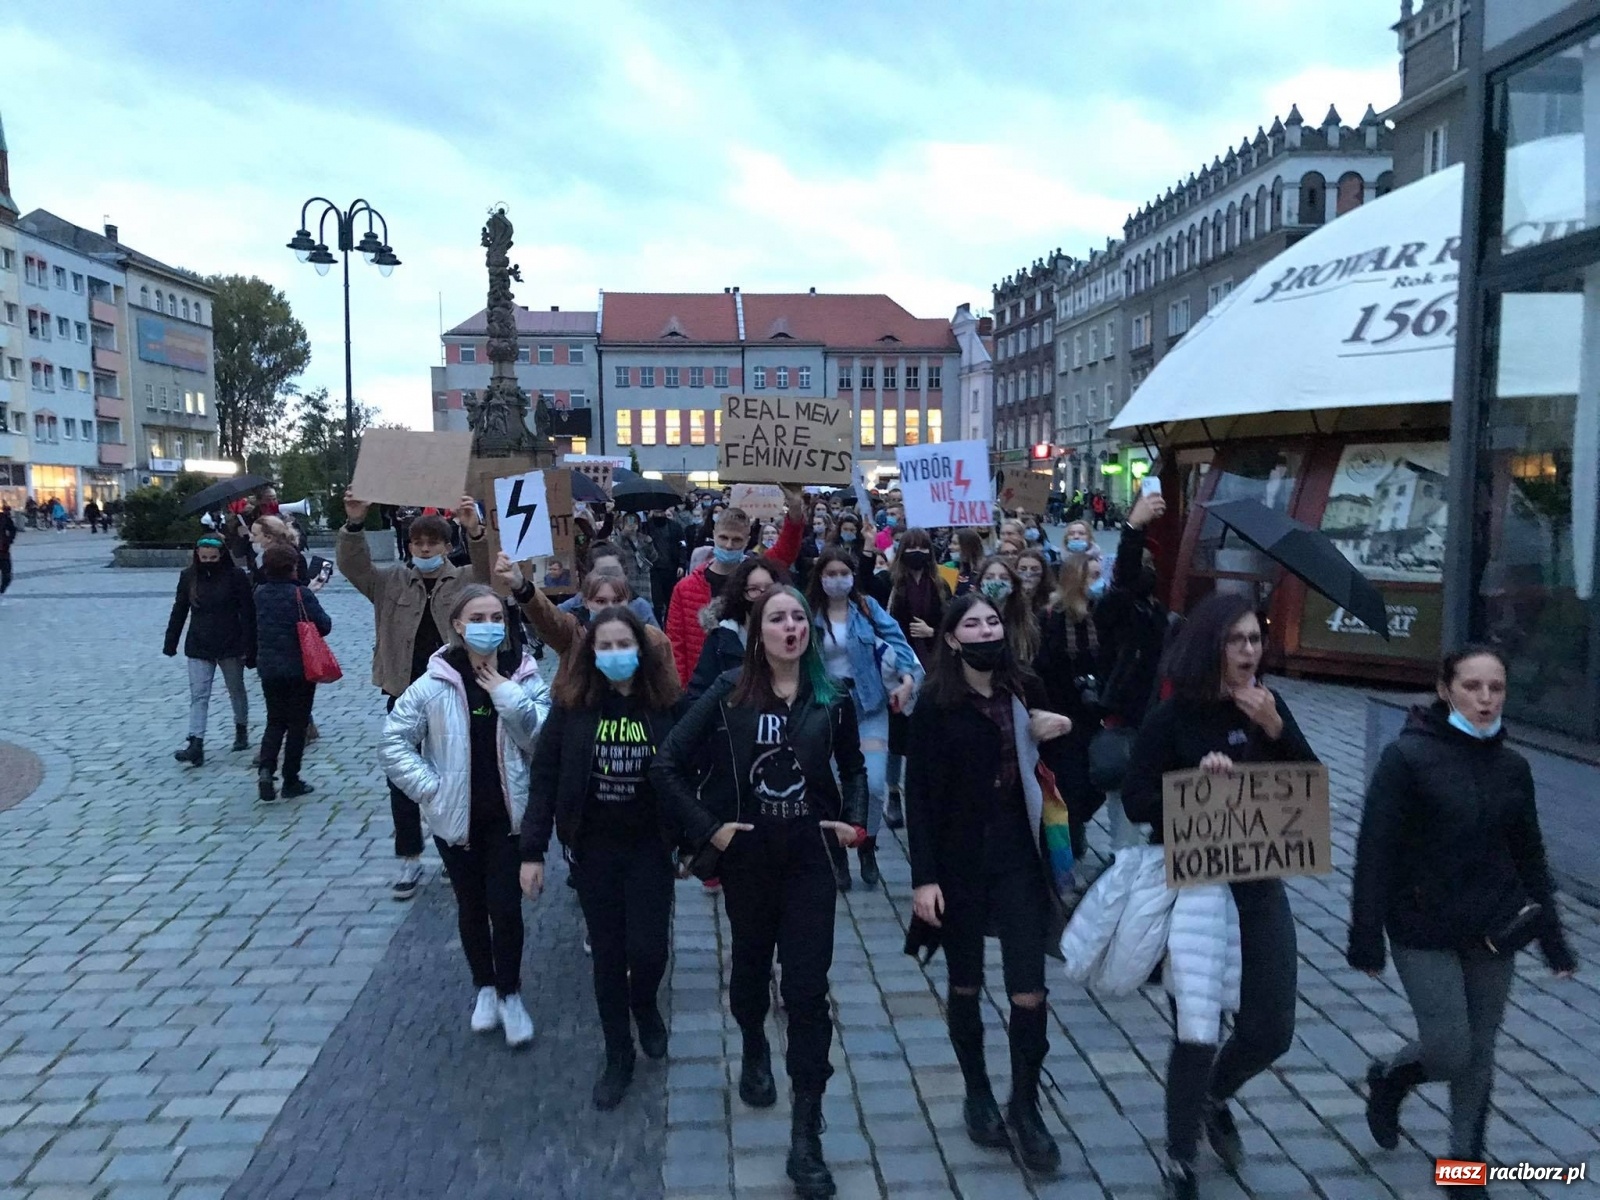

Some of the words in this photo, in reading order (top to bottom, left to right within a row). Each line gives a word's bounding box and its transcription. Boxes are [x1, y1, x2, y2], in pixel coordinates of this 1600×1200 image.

[1341, 291, 1458, 345] 156
[728, 397, 790, 420] REAL
[796, 401, 839, 425] MEN
[751, 424, 811, 446] ARE
[725, 443, 852, 472] FEMINISTS
[930, 481, 954, 503] NIE
[1173, 775, 1212, 810] TO
[1226, 769, 1319, 808] JEST
[1173, 807, 1268, 843] WOJNA
[1280, 806, 1304, 838] Z
[1173, 838, 1315, 882] KOBIETAMI
